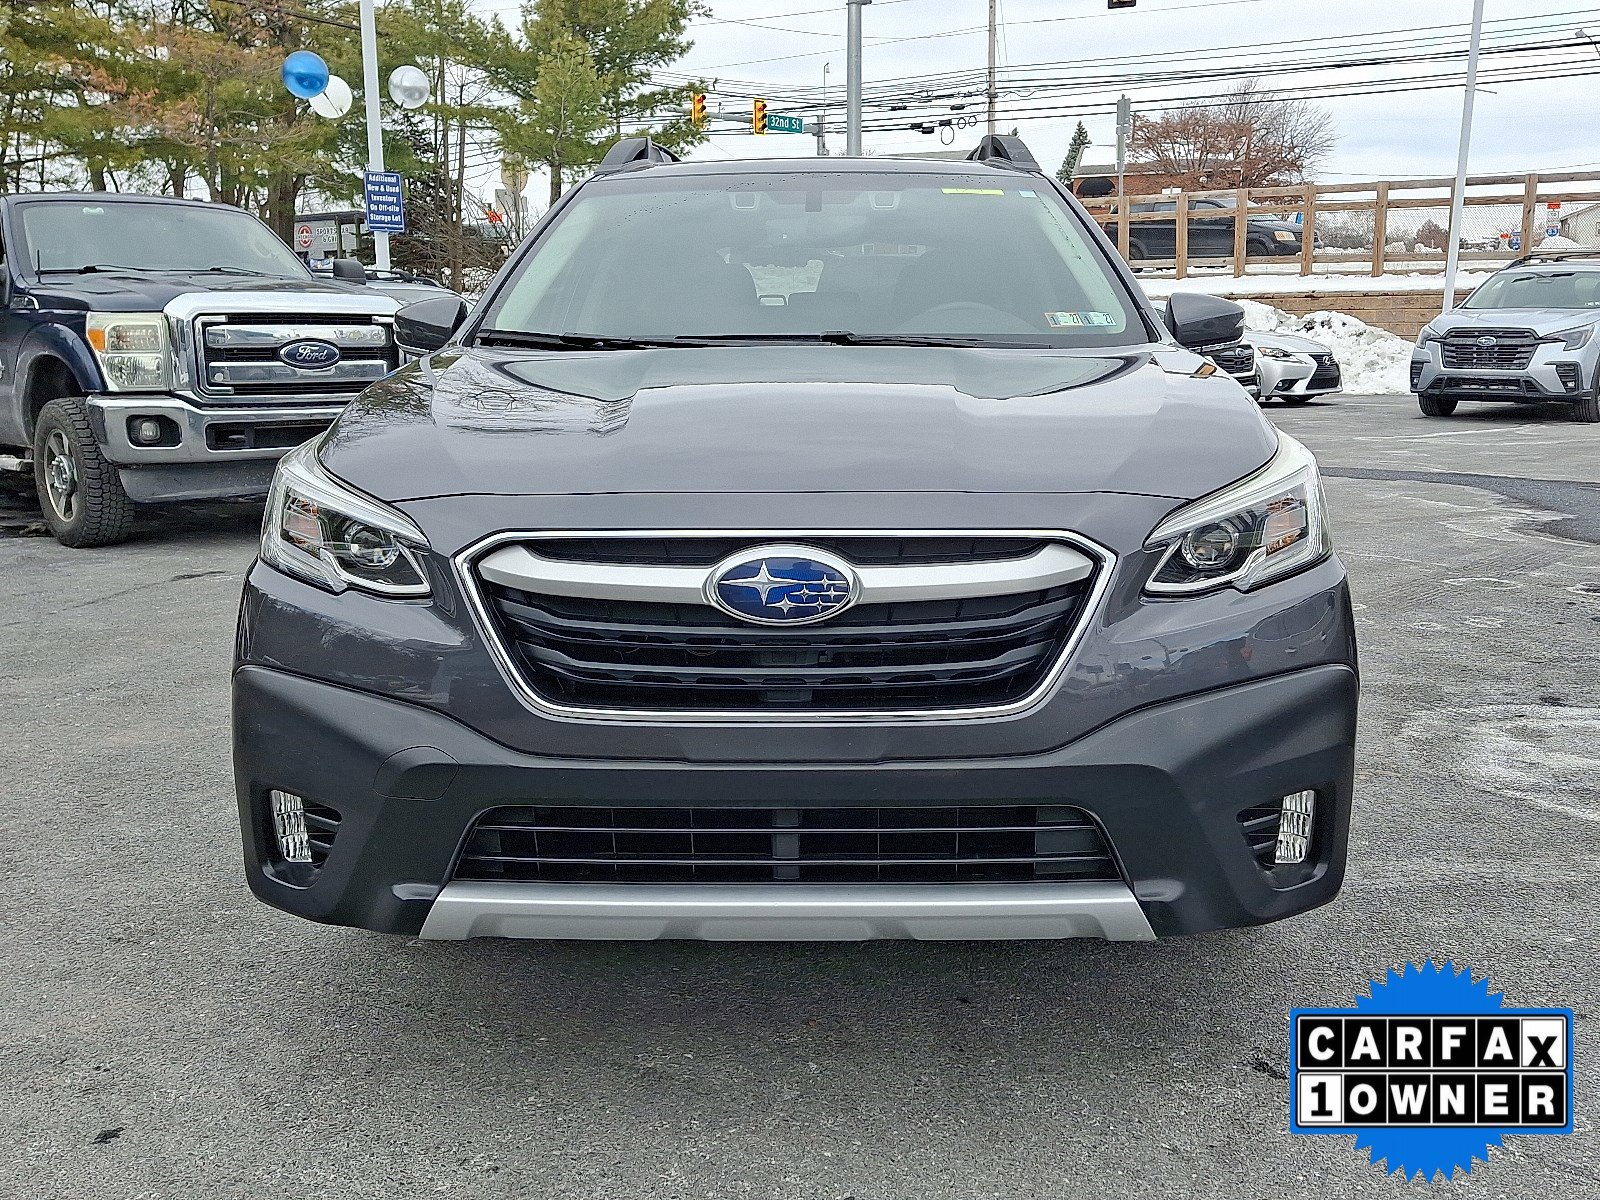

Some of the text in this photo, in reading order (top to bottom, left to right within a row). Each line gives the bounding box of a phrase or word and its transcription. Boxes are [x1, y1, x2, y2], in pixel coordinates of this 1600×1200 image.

[770, 115, 800, 130] 32nd St
[368, 174, 397, 183] Additional
[367, 183, 400, 193] New & Used
[370, 193, 398, 204] Inventory
[378, 204, 400, 212] Off-site
[369, 213, 402, 222] Storage Lot
[296, 345, 328, 360] Ford
